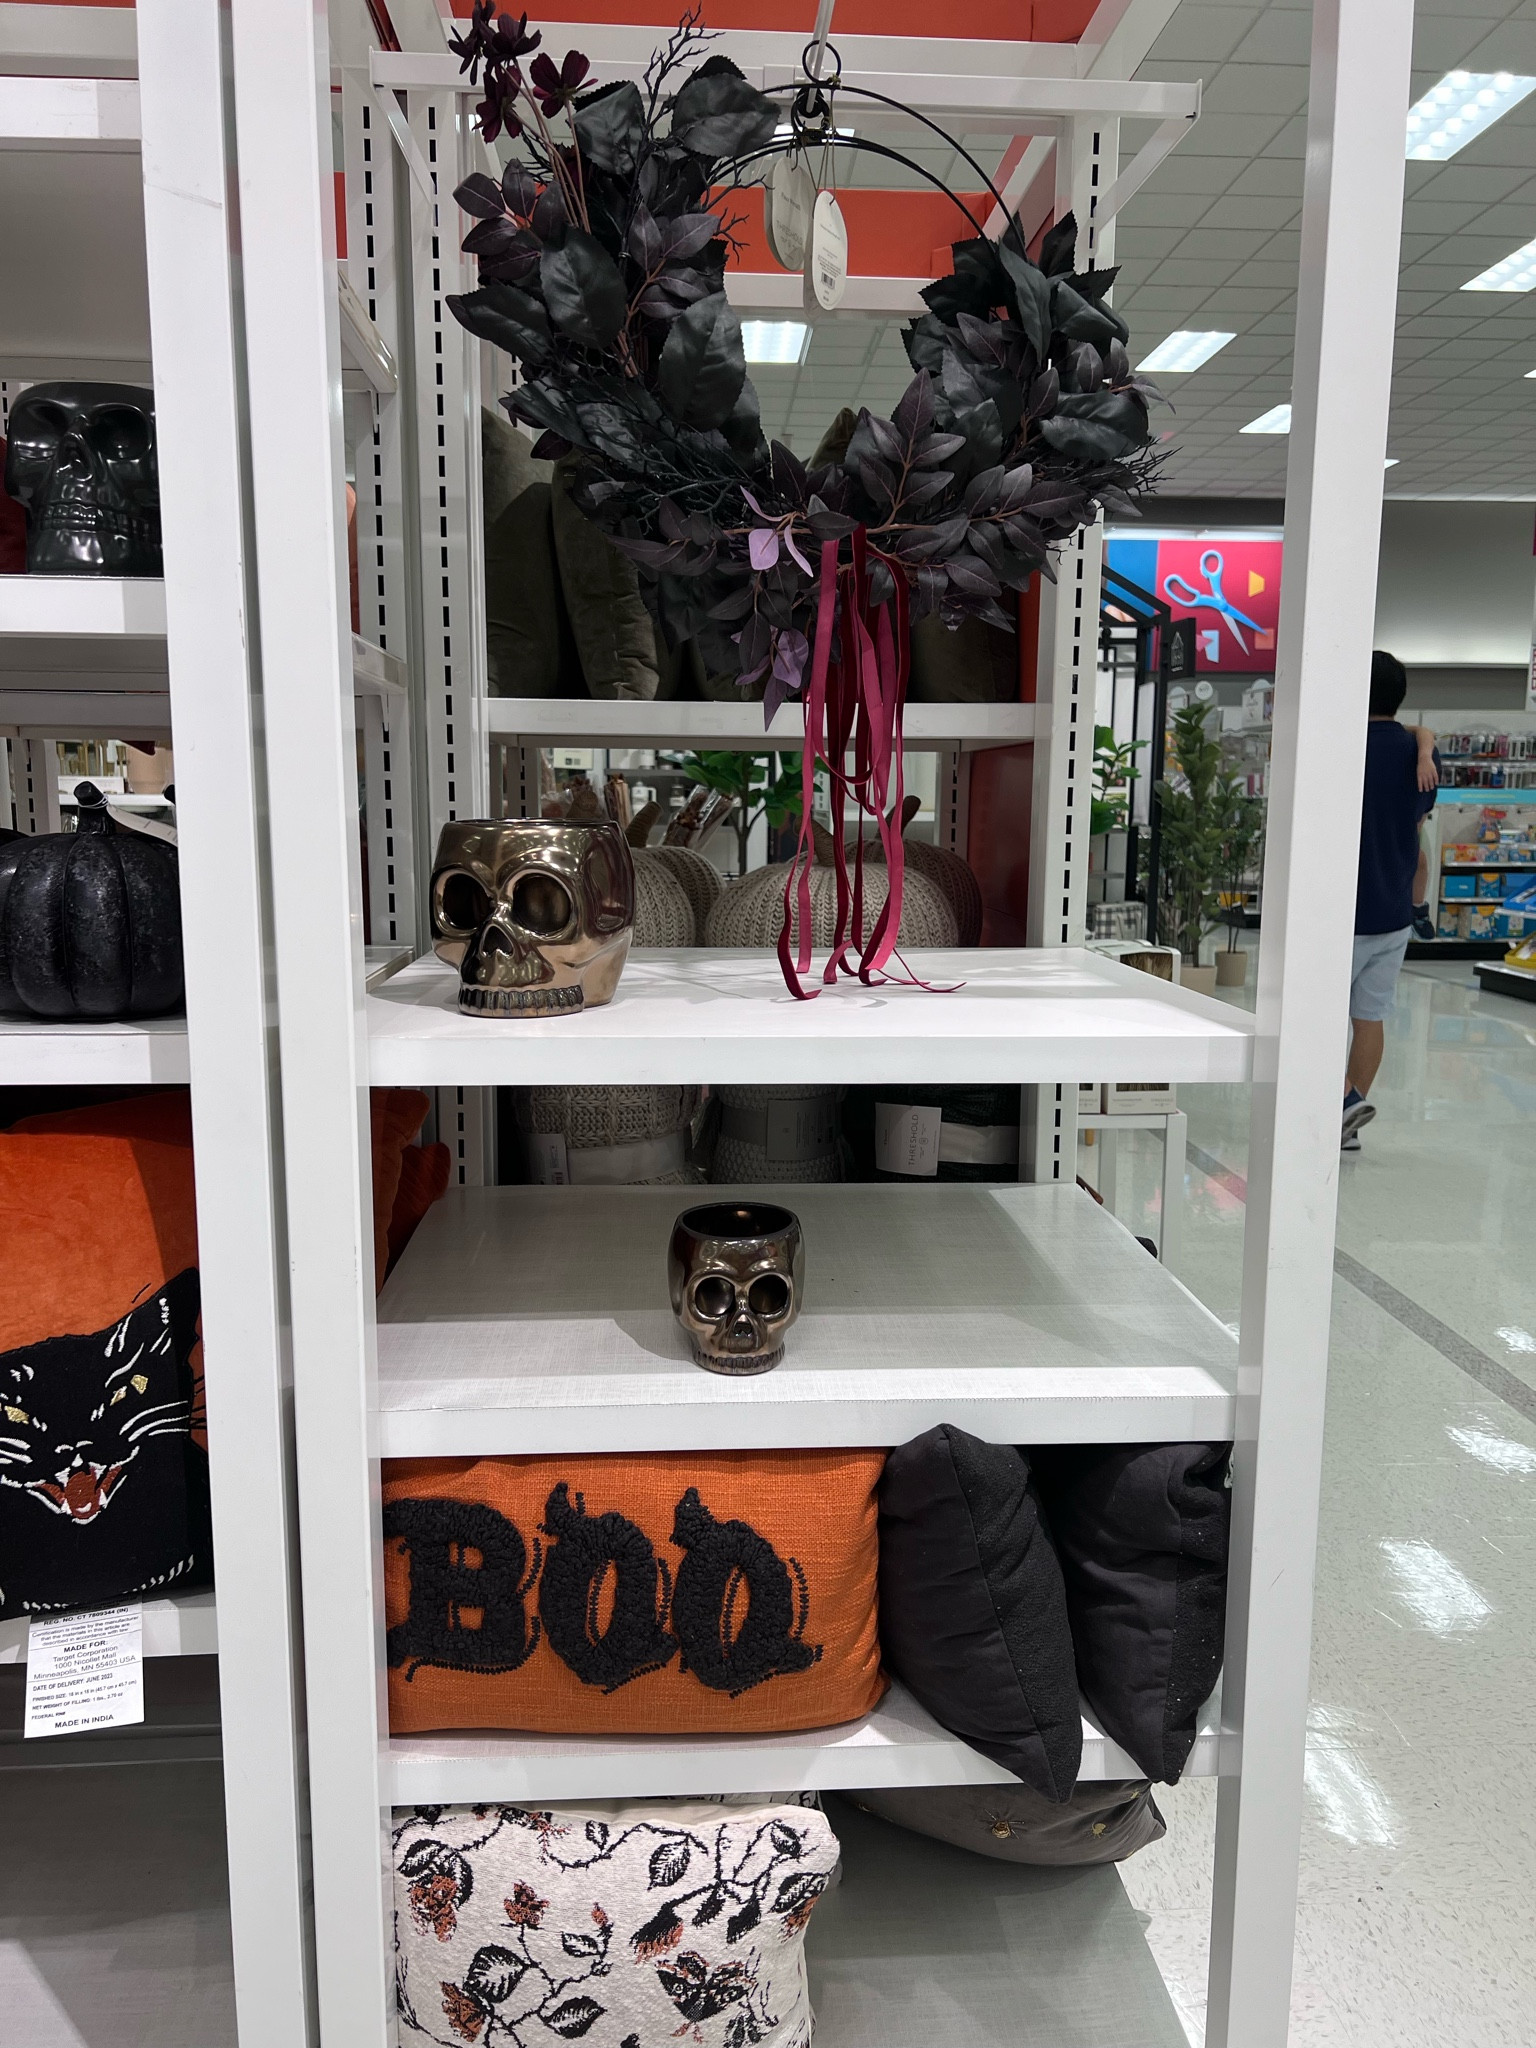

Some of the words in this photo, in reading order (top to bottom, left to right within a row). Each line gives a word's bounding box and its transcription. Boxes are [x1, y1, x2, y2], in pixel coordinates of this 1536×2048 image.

[908, 1114, 918, 1166] THRESHOLD
[383, 1481, 822, 1695] BOO
[32, 1629, 64, 1638] Certification
[105, 1616, 139, 1625] manufacturer
[62, 1630, 86, 1638] materials
[76, 1632, 106, 1640] accordance
[54, 1654, 75, 1663] Target
[77, 1645, 118, 1658] Corporation
[64, 1644, 87, 1652] MADE
[89, 1640, 108, 1648] FOR:
[55, 1660, 72, 1669] 1000
[74, 1655, 100, 1665] Nicollet
[102, 1652, 116, 1660] Mall
[81, 1663, 93, 1671] MN
[96, 1658, 117, 1668] 55403
[120, 1655, 136, 1663] USA
[55, 1720, 79, 1728] MADE
[92, 1714, 113, 1723] INDIA
